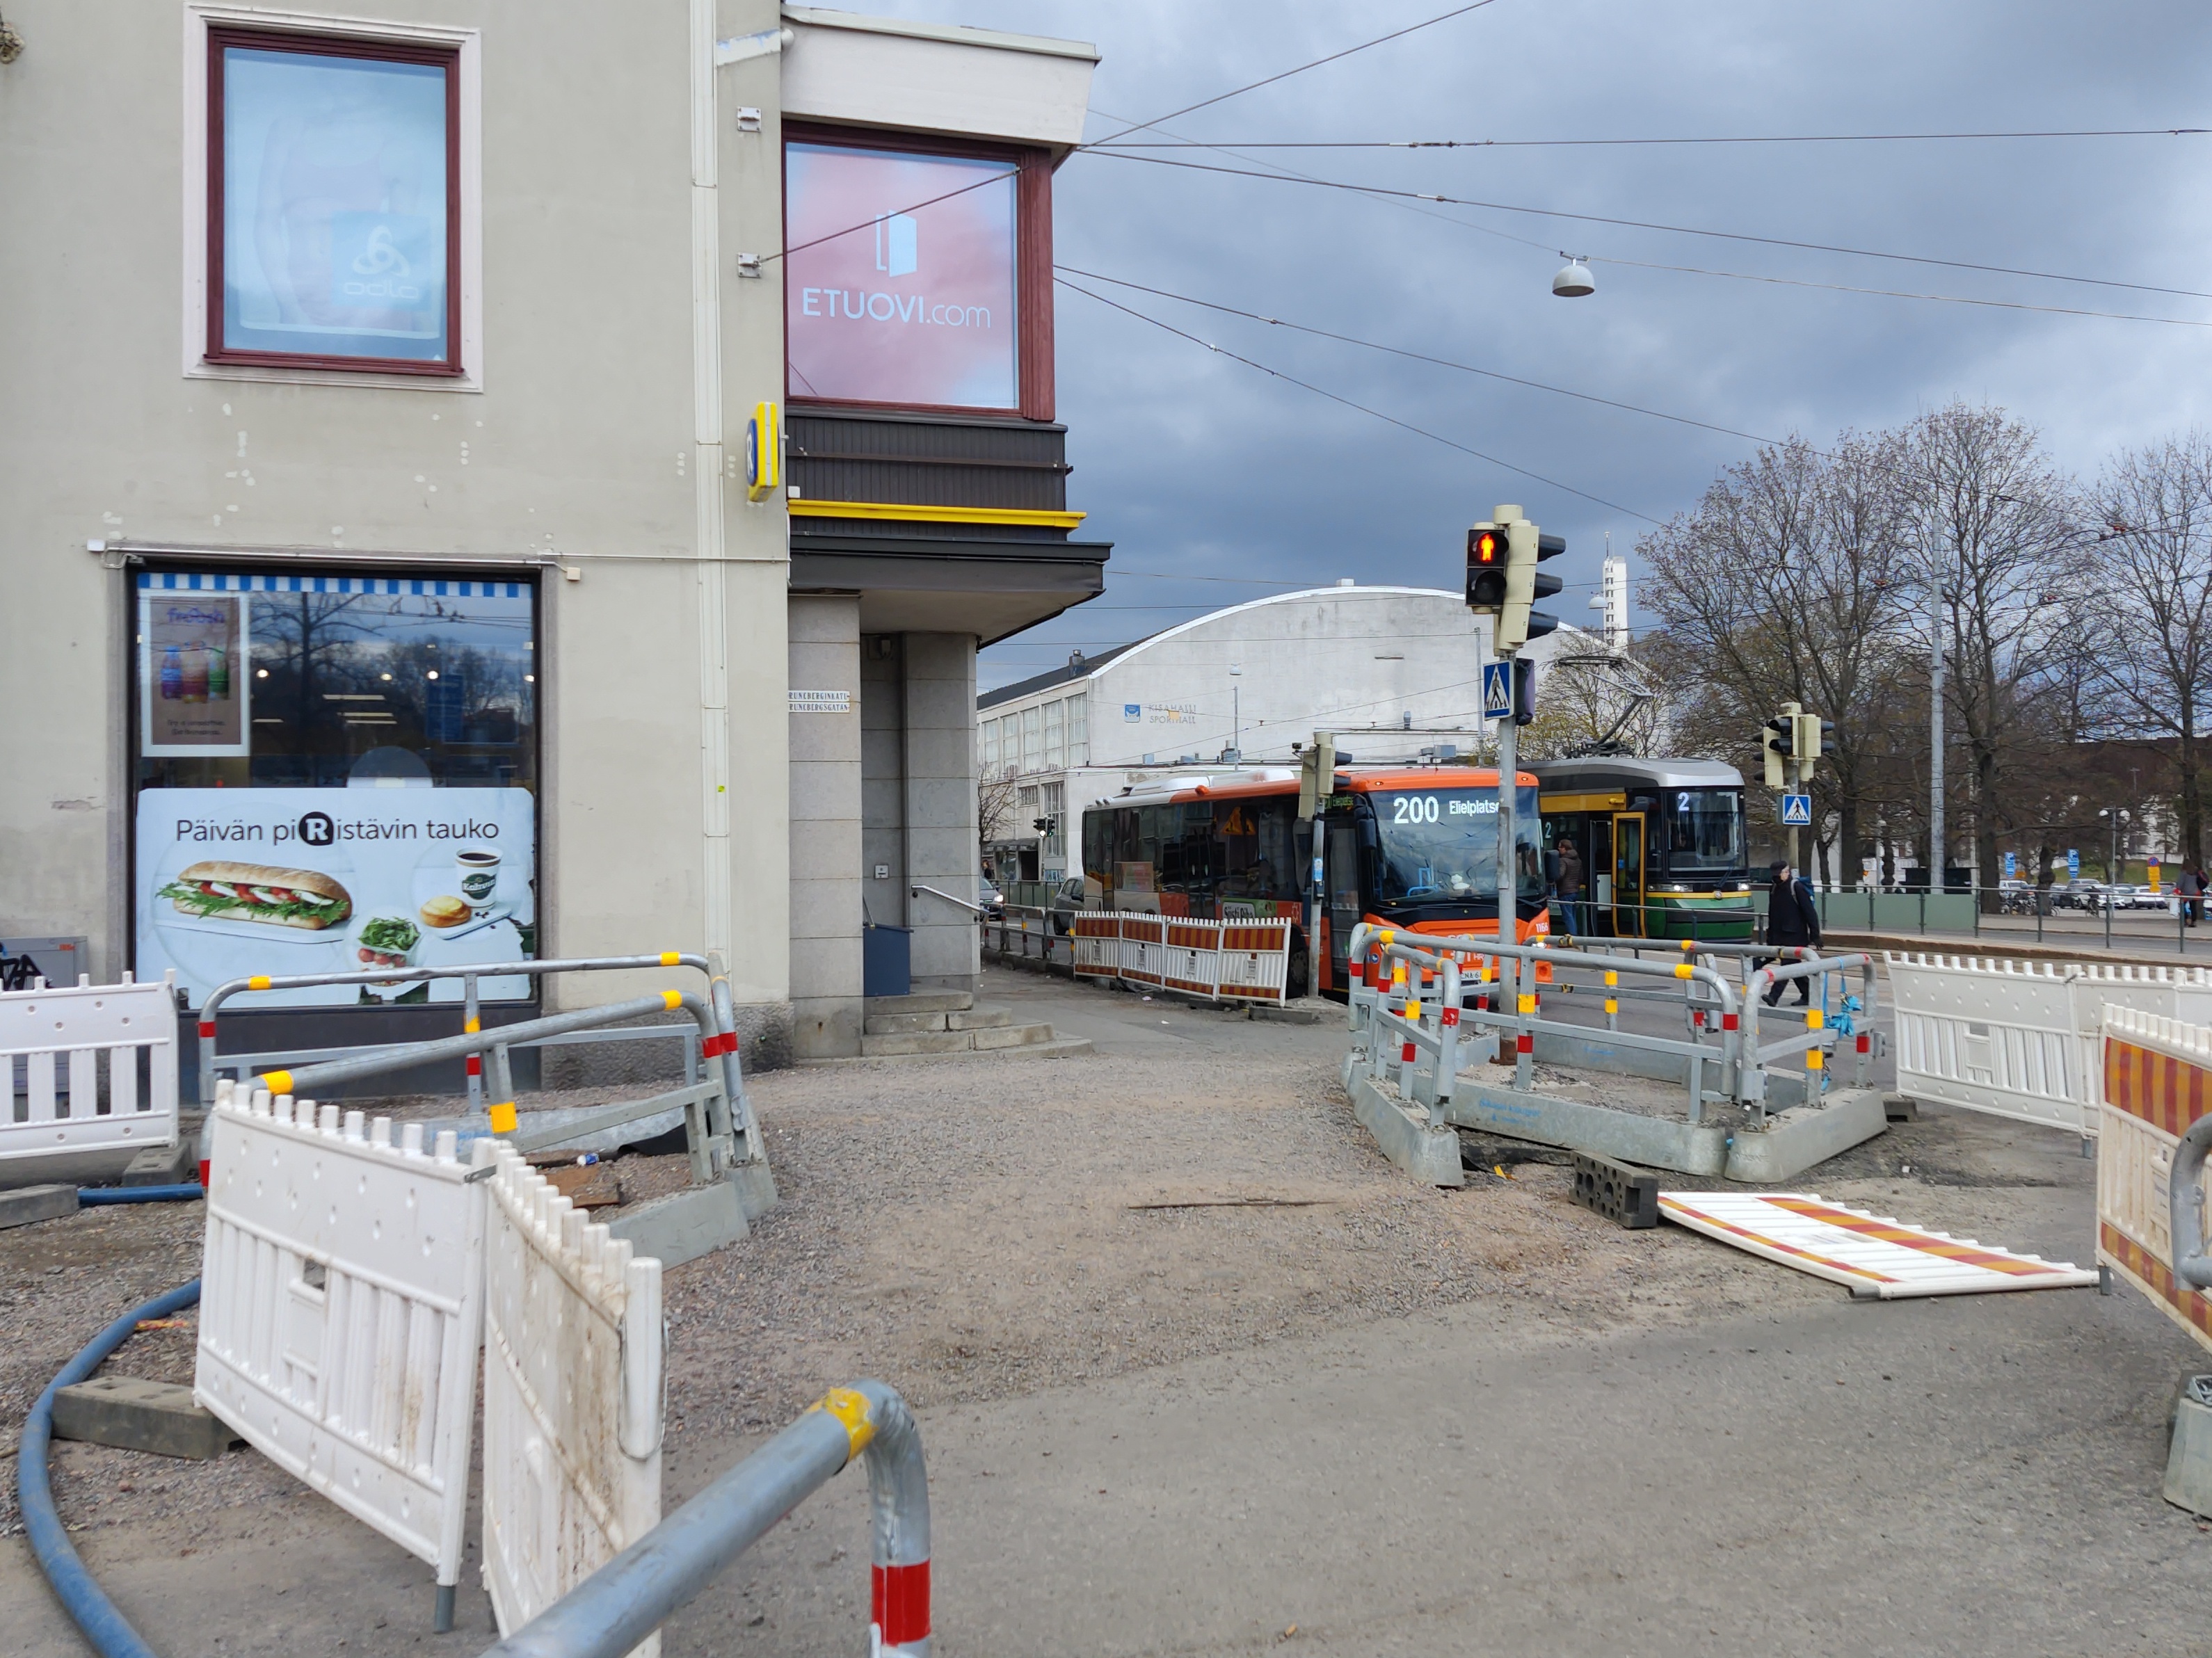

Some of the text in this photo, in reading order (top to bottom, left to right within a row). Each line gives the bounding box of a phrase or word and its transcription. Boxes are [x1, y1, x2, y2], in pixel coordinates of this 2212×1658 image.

[803, 287, 991, 328] ETUOVI.com
[1393, 796, 1439, 824] 200
[1678, 792, 1690, 811] 2
[177, 819, 263, 842] Päivän
[426, 818, 499, 839] tauko
[1545, 821, 1552, 839] 2
